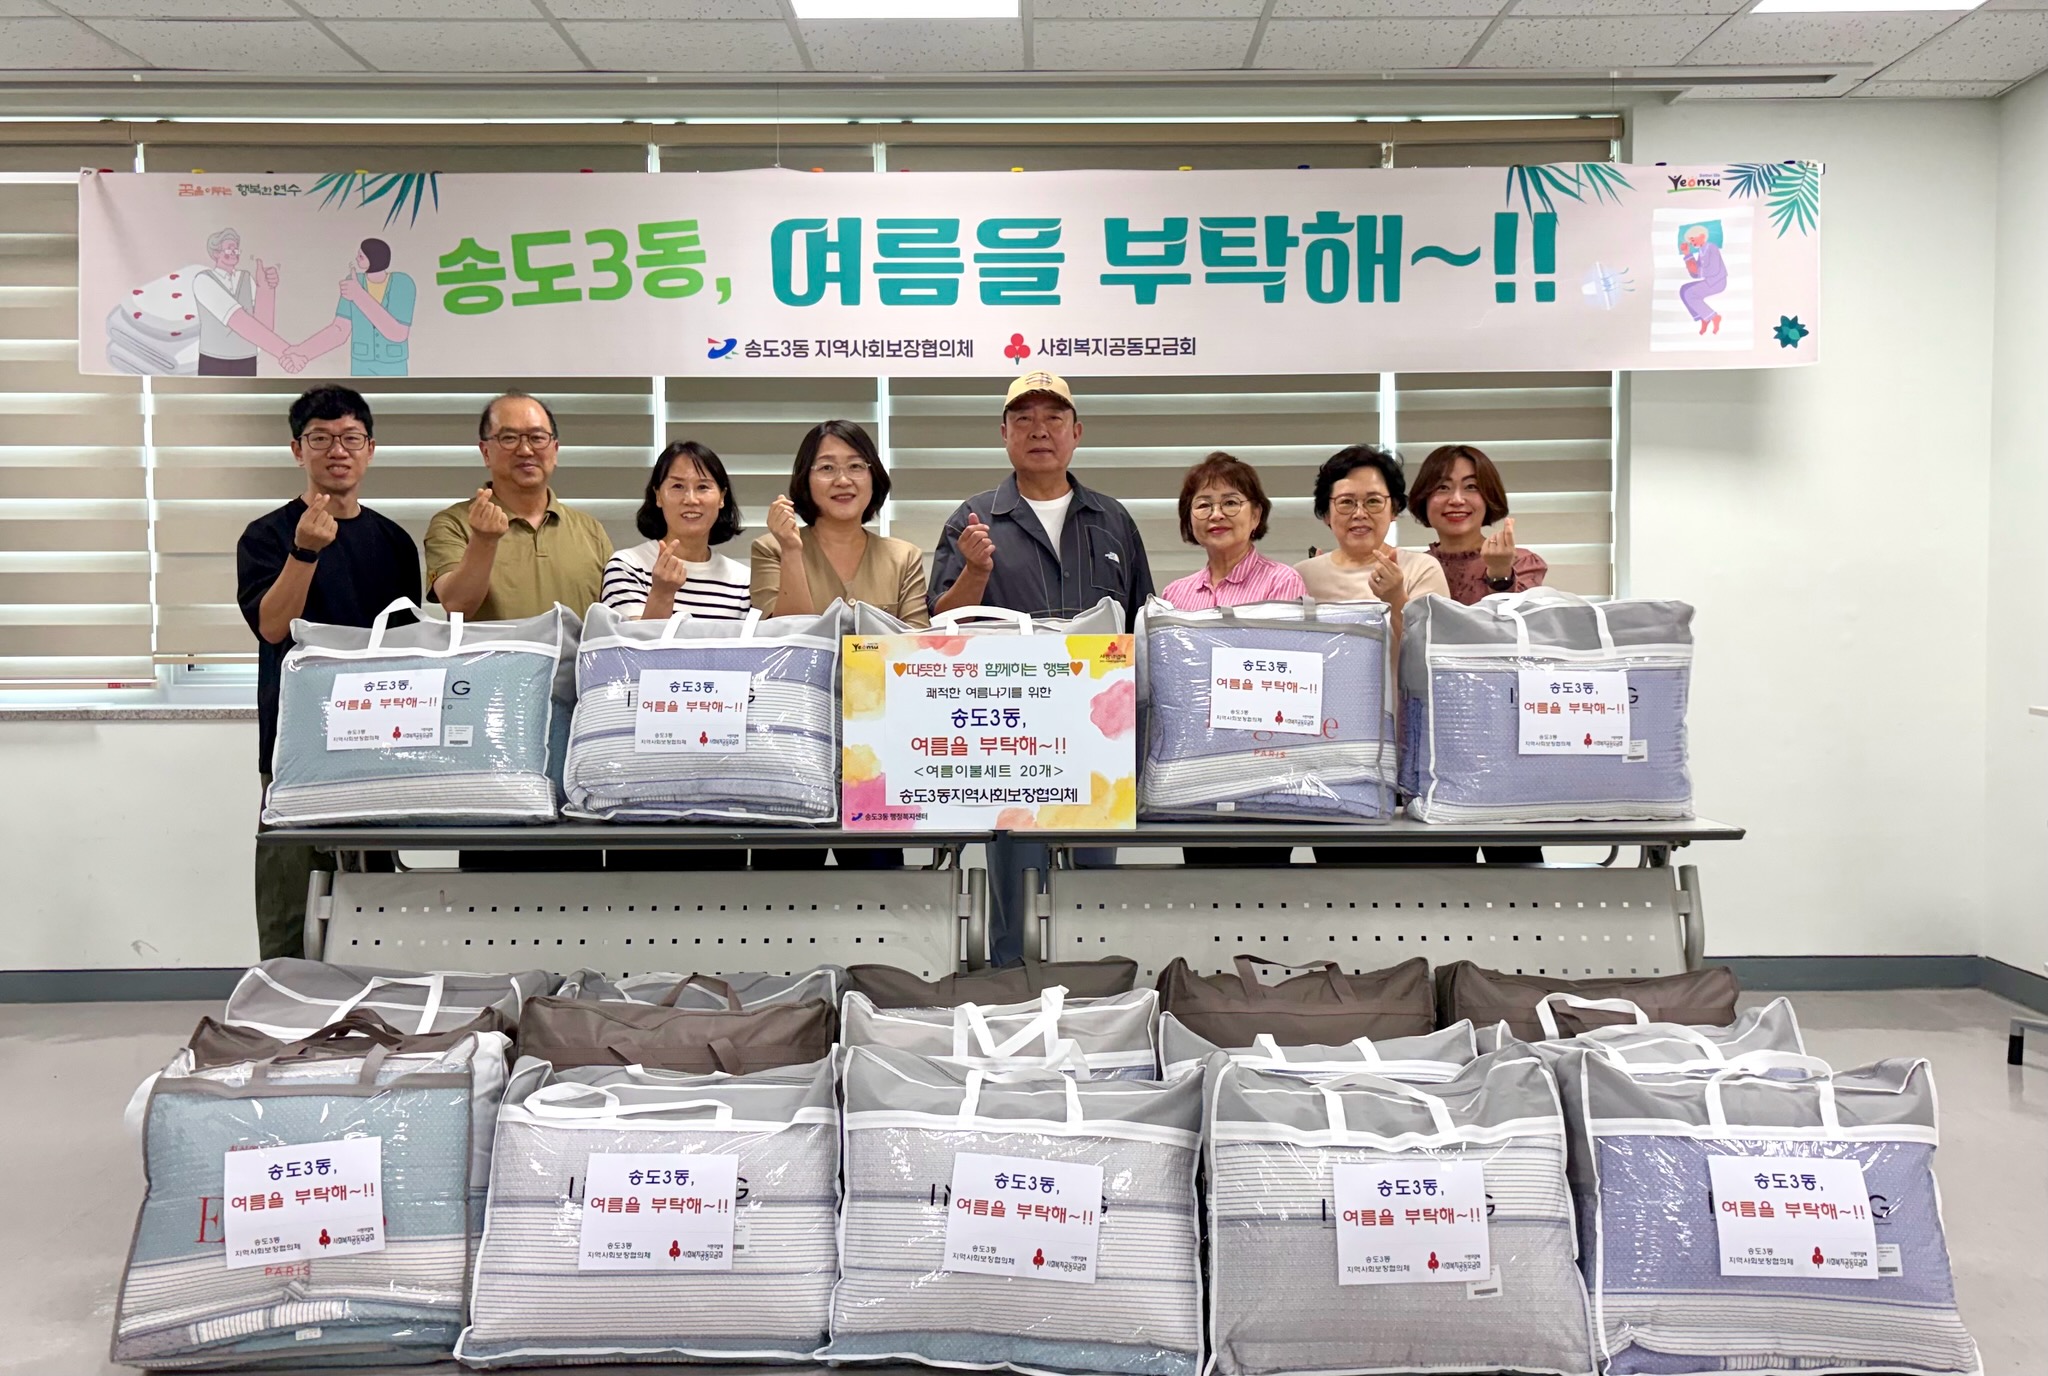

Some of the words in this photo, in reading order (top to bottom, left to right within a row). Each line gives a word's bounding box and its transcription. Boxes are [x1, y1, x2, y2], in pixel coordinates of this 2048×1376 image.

[273, 184, 302, 197] 연수
[1668, 175, 1720, 191] Yeonsu
[436, 219, 731, 316] 송도3동,
[771, 217, 1065, 307] 여름을
[1100, 211, 1557, 305] 부탁해~!!
[744, 338, 810, 359] 송도3동
[815, 337, 974, 360] 지역사회보장협의체
[1037, 336, 1197, 358] 사회복지공동모금회
[906, 663, 947, 677] 따뜻한
[952, 663, 978, 678] 동행
[985, 663, 1037, 677] 함께하는
[1043, 662, 1071, 677] 행복
[1243, 660, 1291, 673] 송도3동,
[364, 680, 412, 692] 송도3동,
[670, 681, 718, 693] 송도3동,
[926, 687, 961, 699] 쾌적한
[966, 687, 1022, 698] 여름나기를
[1028, 687, 1051, 698] 위한
[1217, 678, 1253, 690] 여름을
[1261, 680, 1317, 694] 부탁해~!!
[1550, 682, 1598, 694] 송도3동,
[335, 699, 372, 710] 여름을
[380, 697, 437, 709] 부탁해~!!
[642, 701, 678, 712] 여름을
[686, 701, 742, 712] 부탁해~!!
[1524, 702, 1561, 714] 여름을
[1569, 703, 1624, 714] 부탁해~!!
[951, 708, 1026, 728] 송도3동,
[911, 736, 968, 756] 여름을
[980, 736, 1065, 756] 부탁해~!!
[1254, 750, 1286, 758] PARIS
[914, 765, 1011, 778] <여름이불세트
[1020, 765, 1063, 777] 20개>
[900, 788, 1077, 804] 송도3동지역사회보장협의체
[865, 813, 888, 821] 송도3동
[268, 1159, 337, 1180] 송도3동,
[629, 1170, 694, 1186] 송도3동,
[994, 1173, 1059, 1195] 송도3동,
[1754, 1173, 1823, 1191] 송도3동,
[1377, 1179, 1444, 1197] 송도3동,
[232, 1192, 284, 1212] 여름을
[296, 1183, 374, 1205] 부탁해~!!
[591, 1197, 640, 1213] 여름을
[651, 1197, 728, 1214] 부탁해~!!
[957, 1198, 1006, 1217] 여름을
[1017, 1203, 1093, 1225] 부탁해~!!
[1343, 1209, 1394, 1226] 여름을
[1406, 1207, 1480, 1225] 부탁해~!!
[1722, 1201, 1774, 1218] 여름을
[1785, 1202, 1865, 1220] 부탁해~!!
[264, 1266, 312, 1277] PARIS
